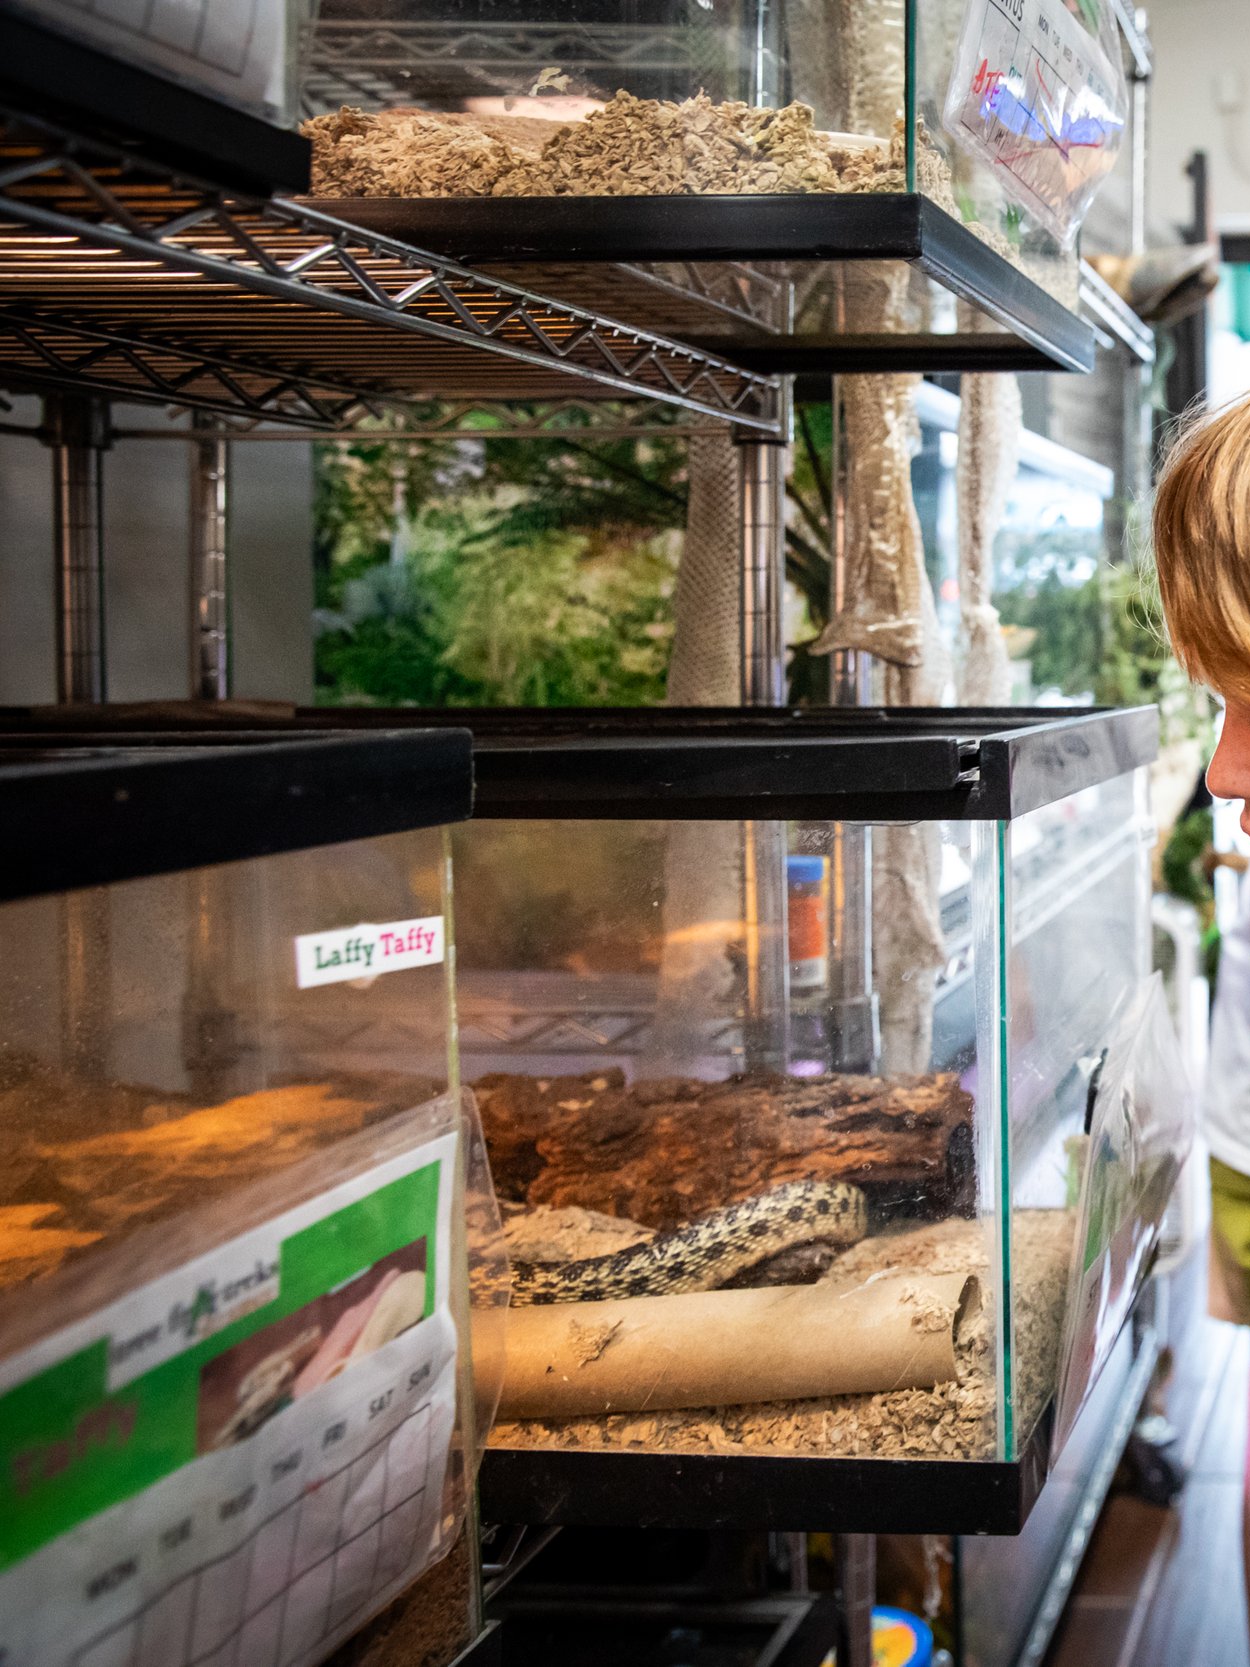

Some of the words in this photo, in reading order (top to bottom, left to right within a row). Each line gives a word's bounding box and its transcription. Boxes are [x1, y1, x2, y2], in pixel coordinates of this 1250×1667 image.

[314, 938, 375, 970] Laffy
[379, 926, 436, 956] Taffy
[369, 1388, 393, 1420] SAT
